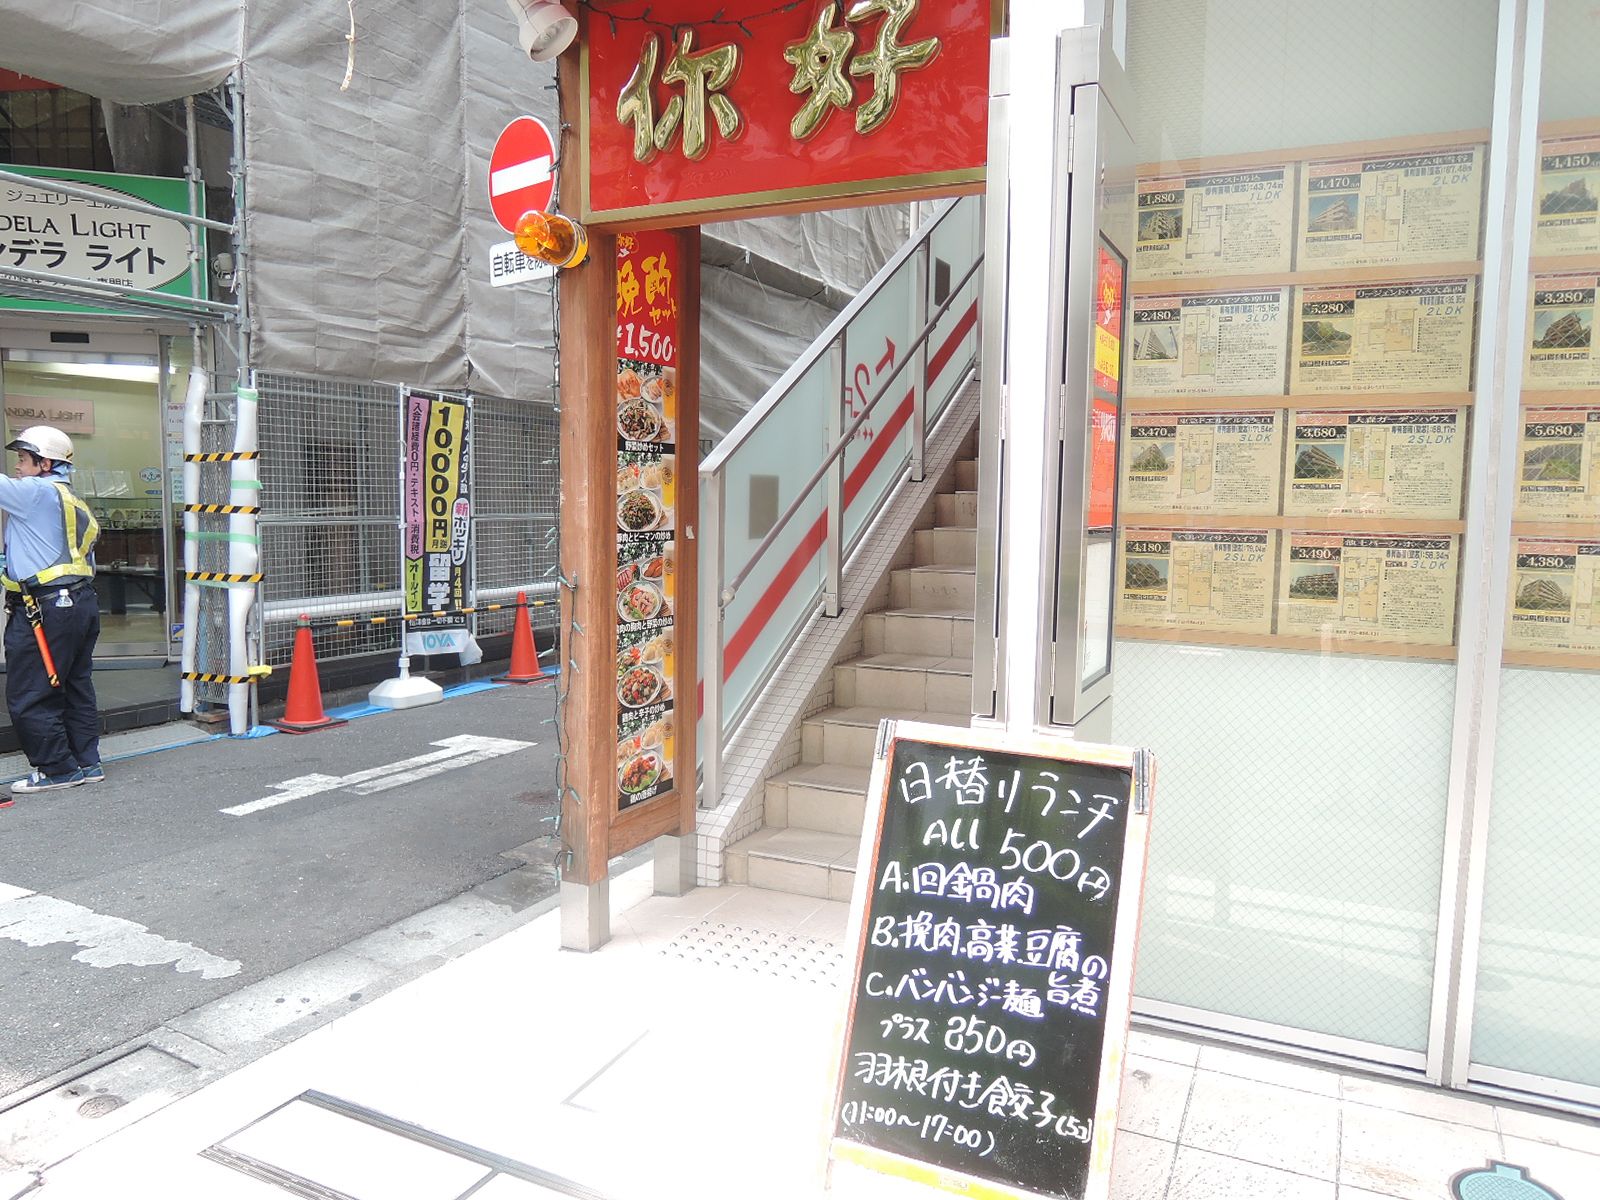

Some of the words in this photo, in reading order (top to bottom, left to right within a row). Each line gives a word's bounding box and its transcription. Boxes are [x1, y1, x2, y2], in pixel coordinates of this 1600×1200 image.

[617, 0, 943, 163] 你好
[1432, 174, 1470, 186] 2LDK
[1250, 190, 1281, 201] 1LDK
[70, 213, 151, 240] LIGHT
[0, 238, 67, 269] デラ
[86, 244, 166, 275] ライト
[1426, 306, 1464, 316] 2LDK
[1245, 313, 1277, 323] 3LDK
[1239, 434, 1272, 442] 3LDK
[1408, 435, 1454, 444] 2SLDK
[431, 406, 453, 538] 10,000円
[1224, 553, 1264, 562] 2SLDK
[1411, 561, 1447, 570] 3LDK
[999, 828, 1112, 902] 500円
[879, 1013, 931, 1044] プラス
[944, 1014, 1037, 1068] 250円
